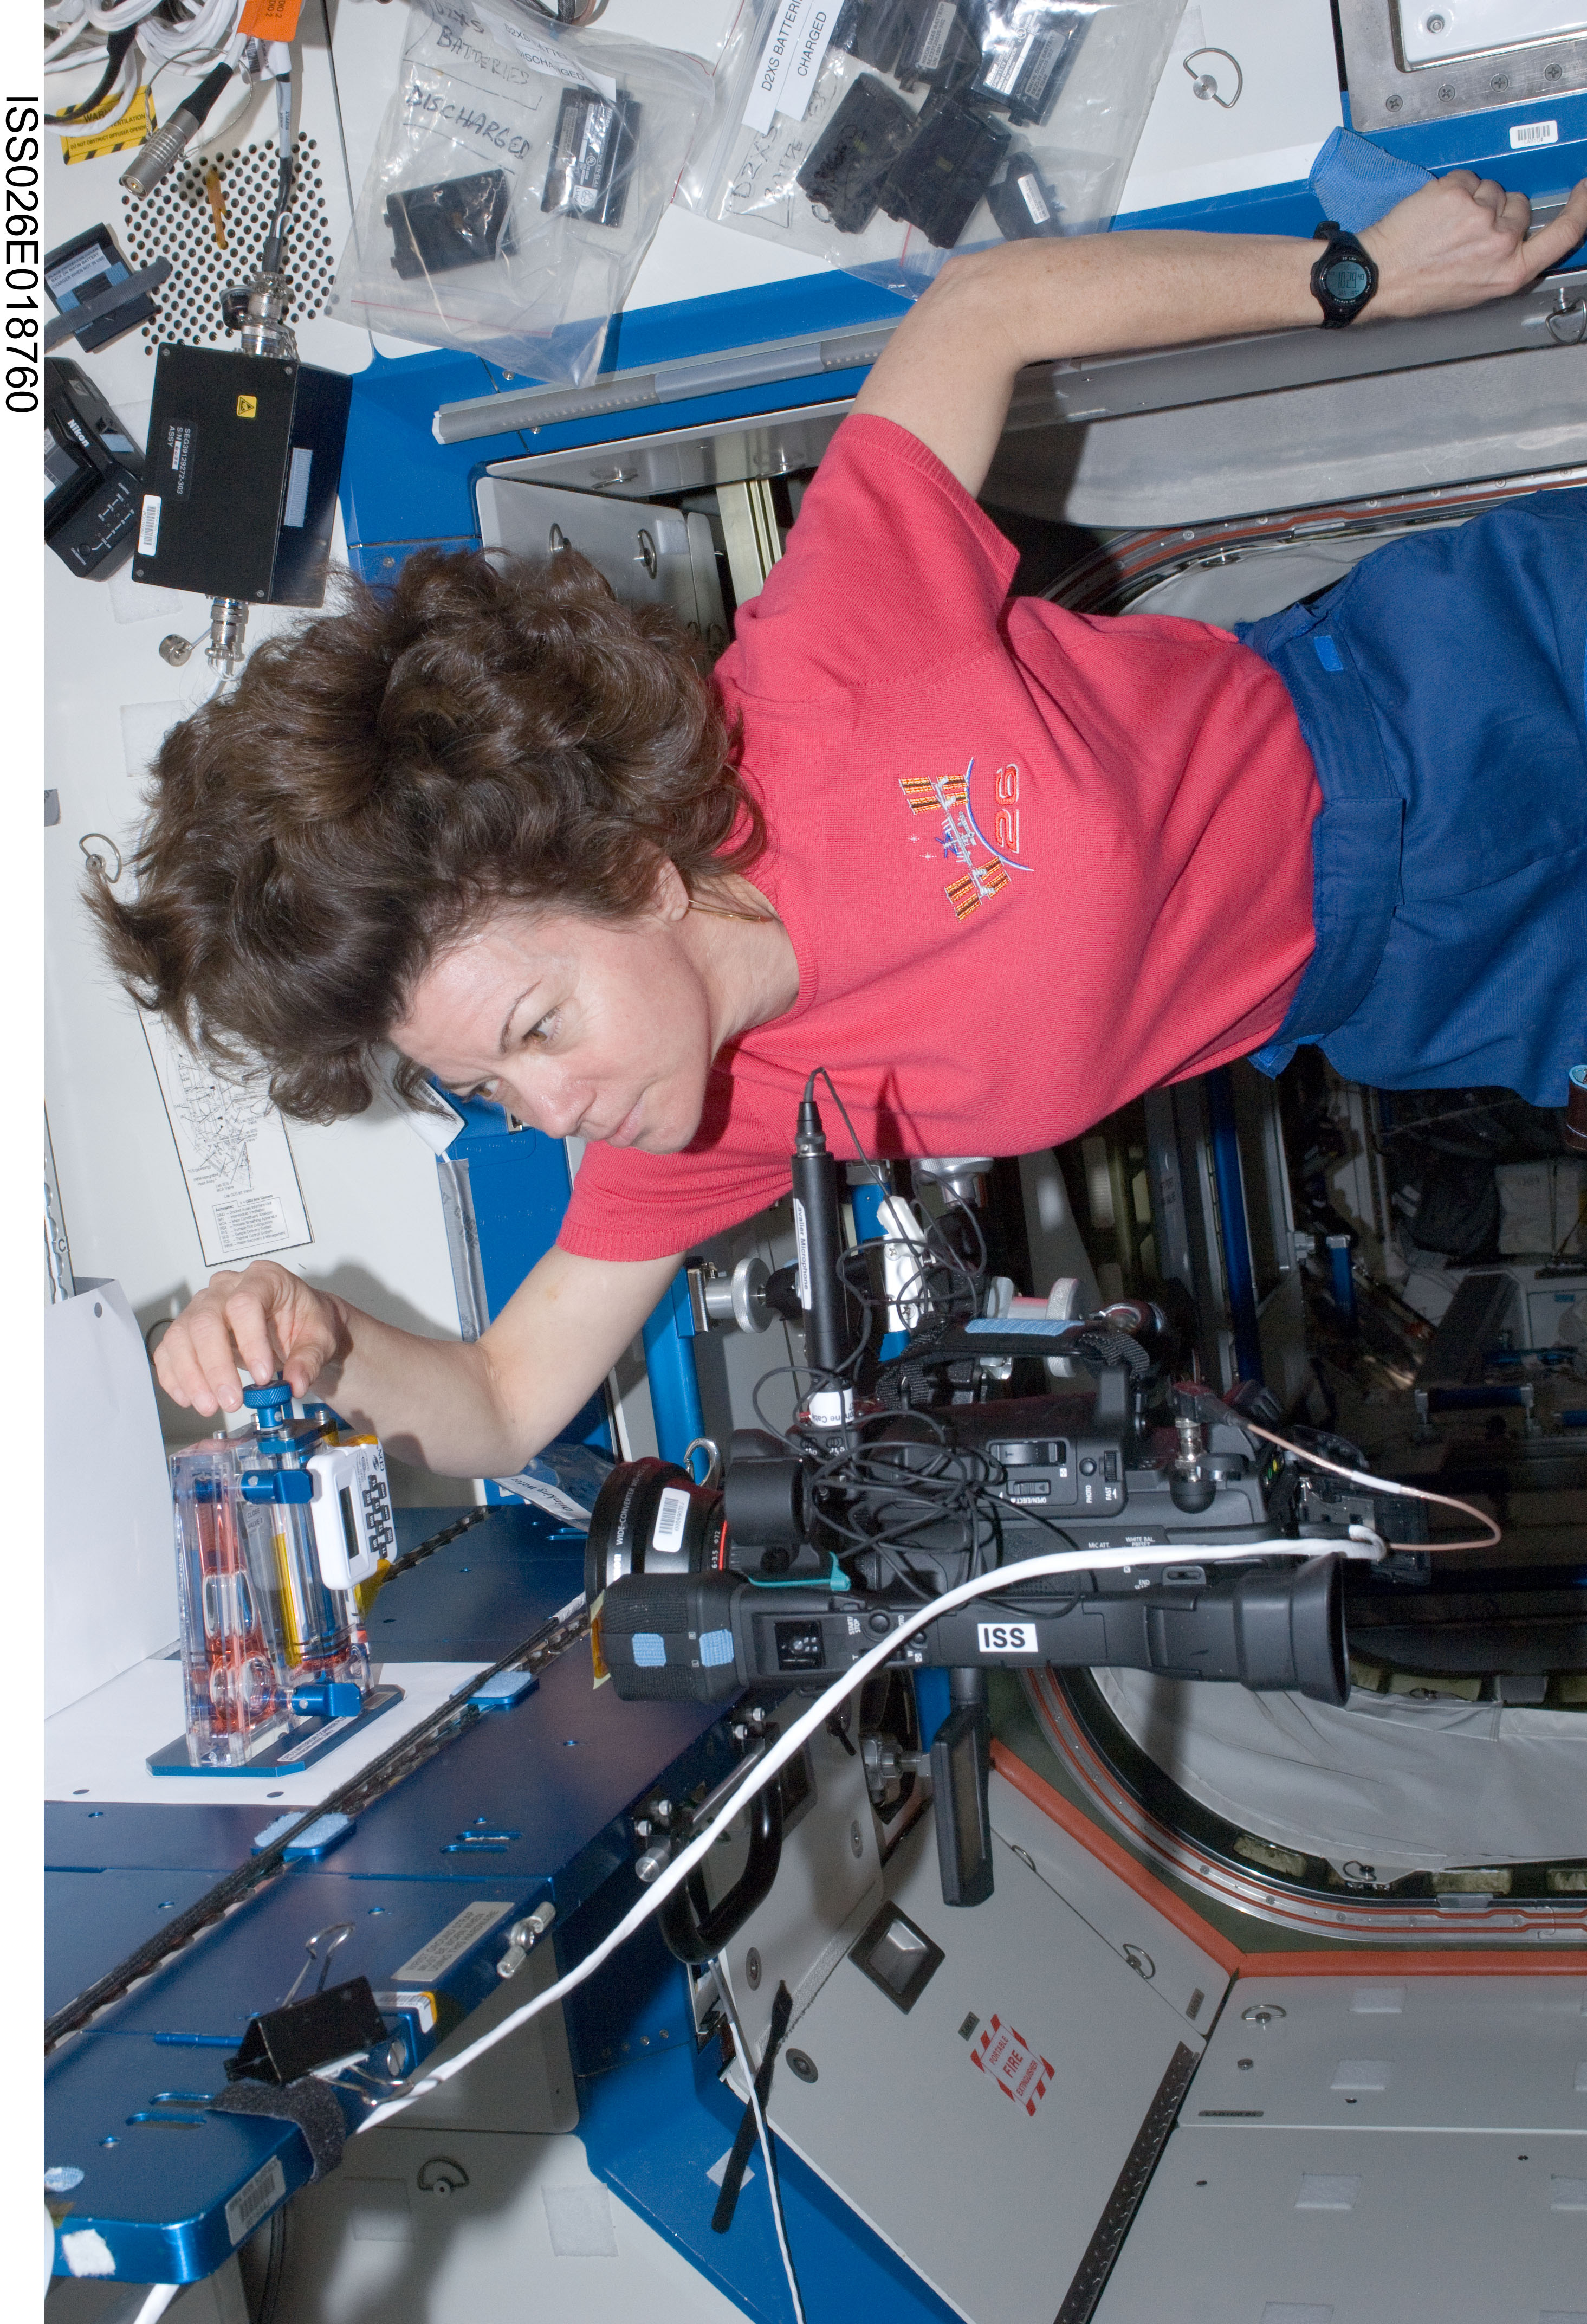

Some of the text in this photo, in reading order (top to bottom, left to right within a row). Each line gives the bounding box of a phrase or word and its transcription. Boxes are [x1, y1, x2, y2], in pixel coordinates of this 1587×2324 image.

[798, 11, 827, 76] CHARGED
[761, 57, 780, 91] D2XS
[984, 63, 999, 85] Nikon
[405, 86, 530, 159] DISCHARGED
[87, 135, 108, 145] OBSTRUCT
[81, 252, 100, 264] BATTERY
[67, 419, 92, 447] Nikon
[177, 428, 190, 494] SEG39129272-303
[996, 764, 1019, 853] 26
[510, 1478, 573, 1512] Drinking Water
[1016, 1496, 1047, 1505] OPEN/EJECT
[616, 1488, 634, 1545] WIDE-CONVERTER
[983, 1628, 1026, 1649] ISS
[989, 2035, 1008, 2065] PORTABLE
[1002, 2049, 1023, 2078] FIRE
[1015, 2060, 1038, 2096] EXTINGUISHER
